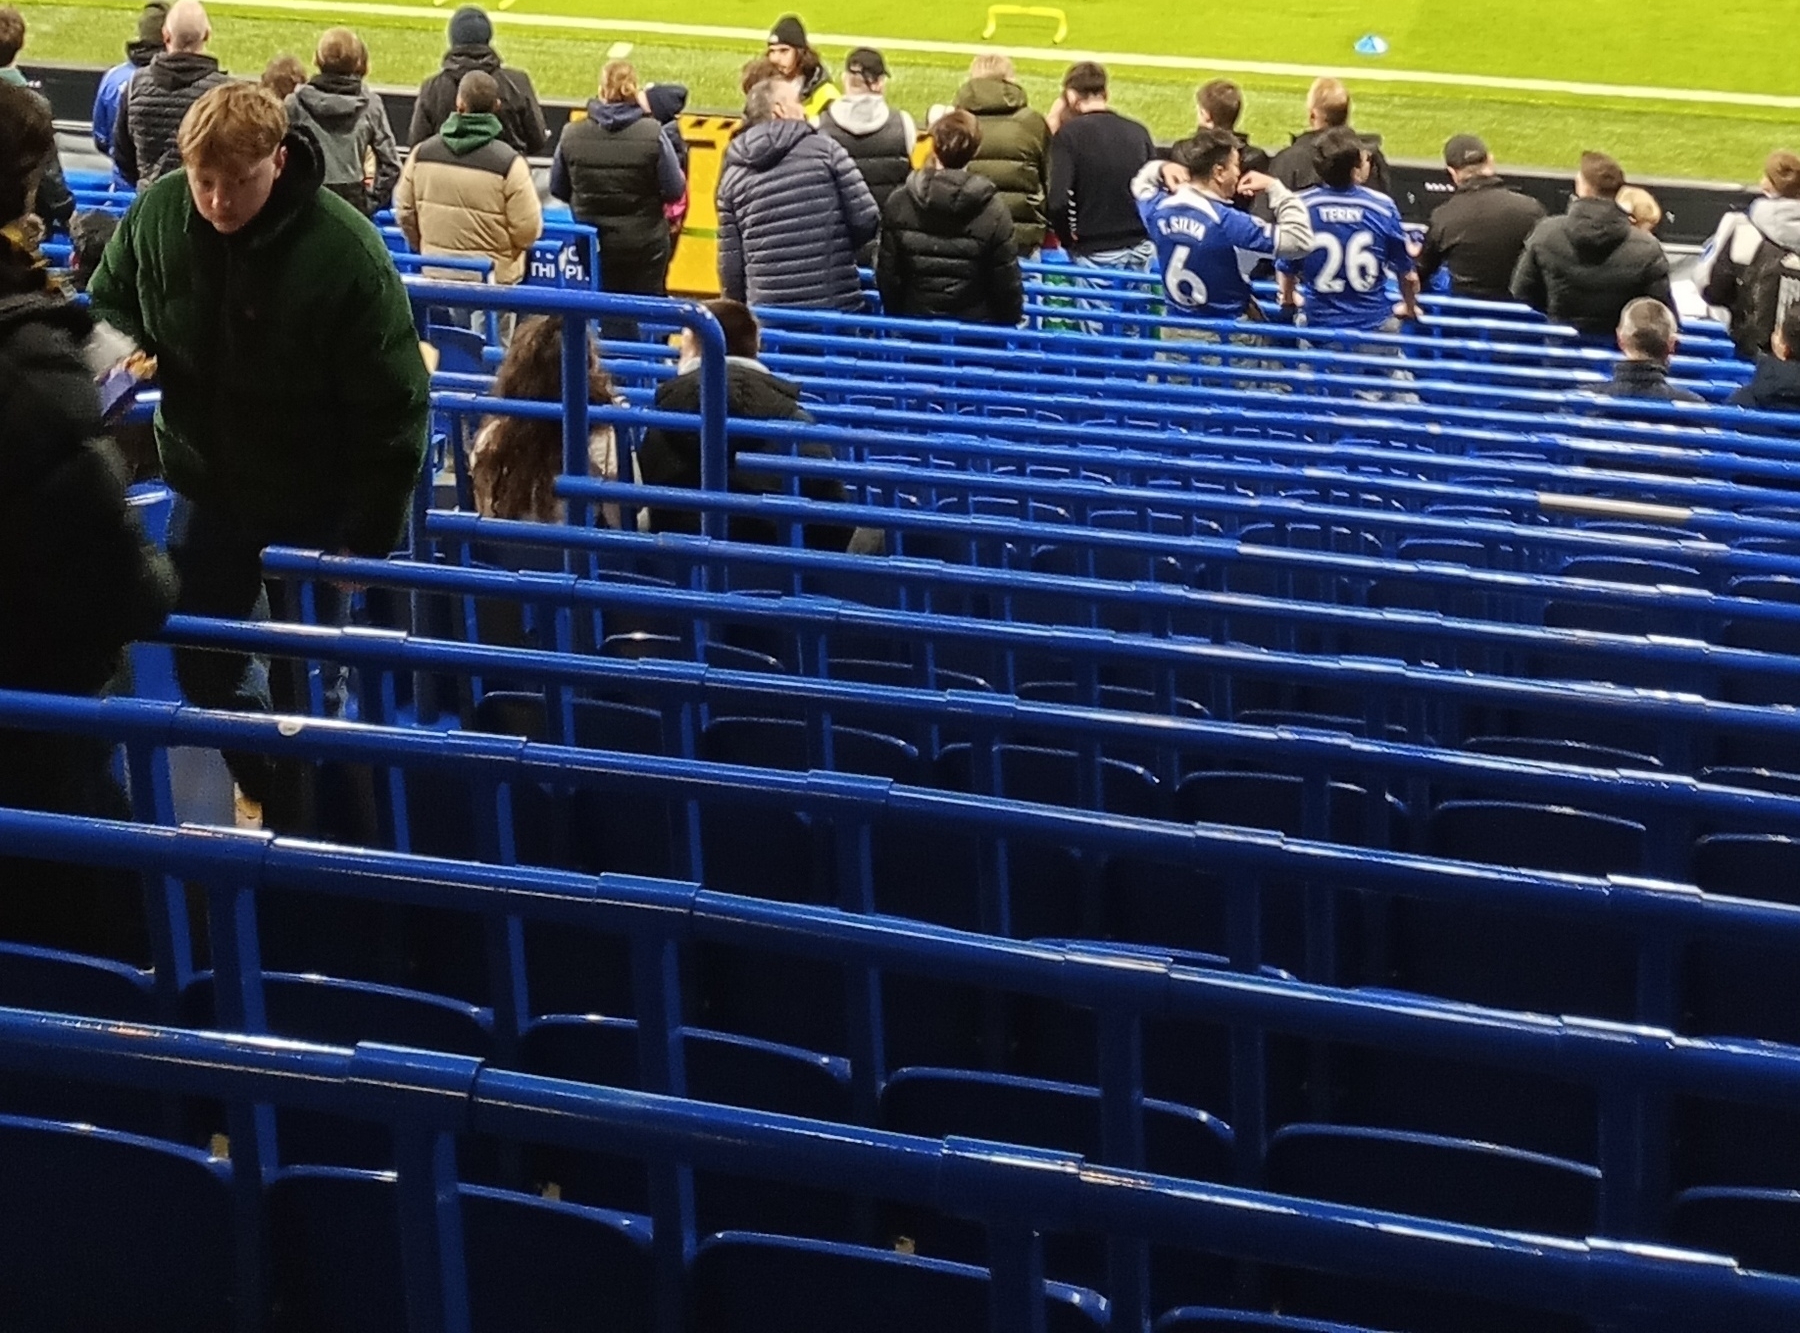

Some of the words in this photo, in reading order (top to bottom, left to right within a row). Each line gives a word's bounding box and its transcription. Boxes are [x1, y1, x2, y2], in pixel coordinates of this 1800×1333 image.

[1317, 205, 1364, 223] TERRY
[1165, 244, 1208, 306] 6
[1313, 230, 1379, 293] 26
